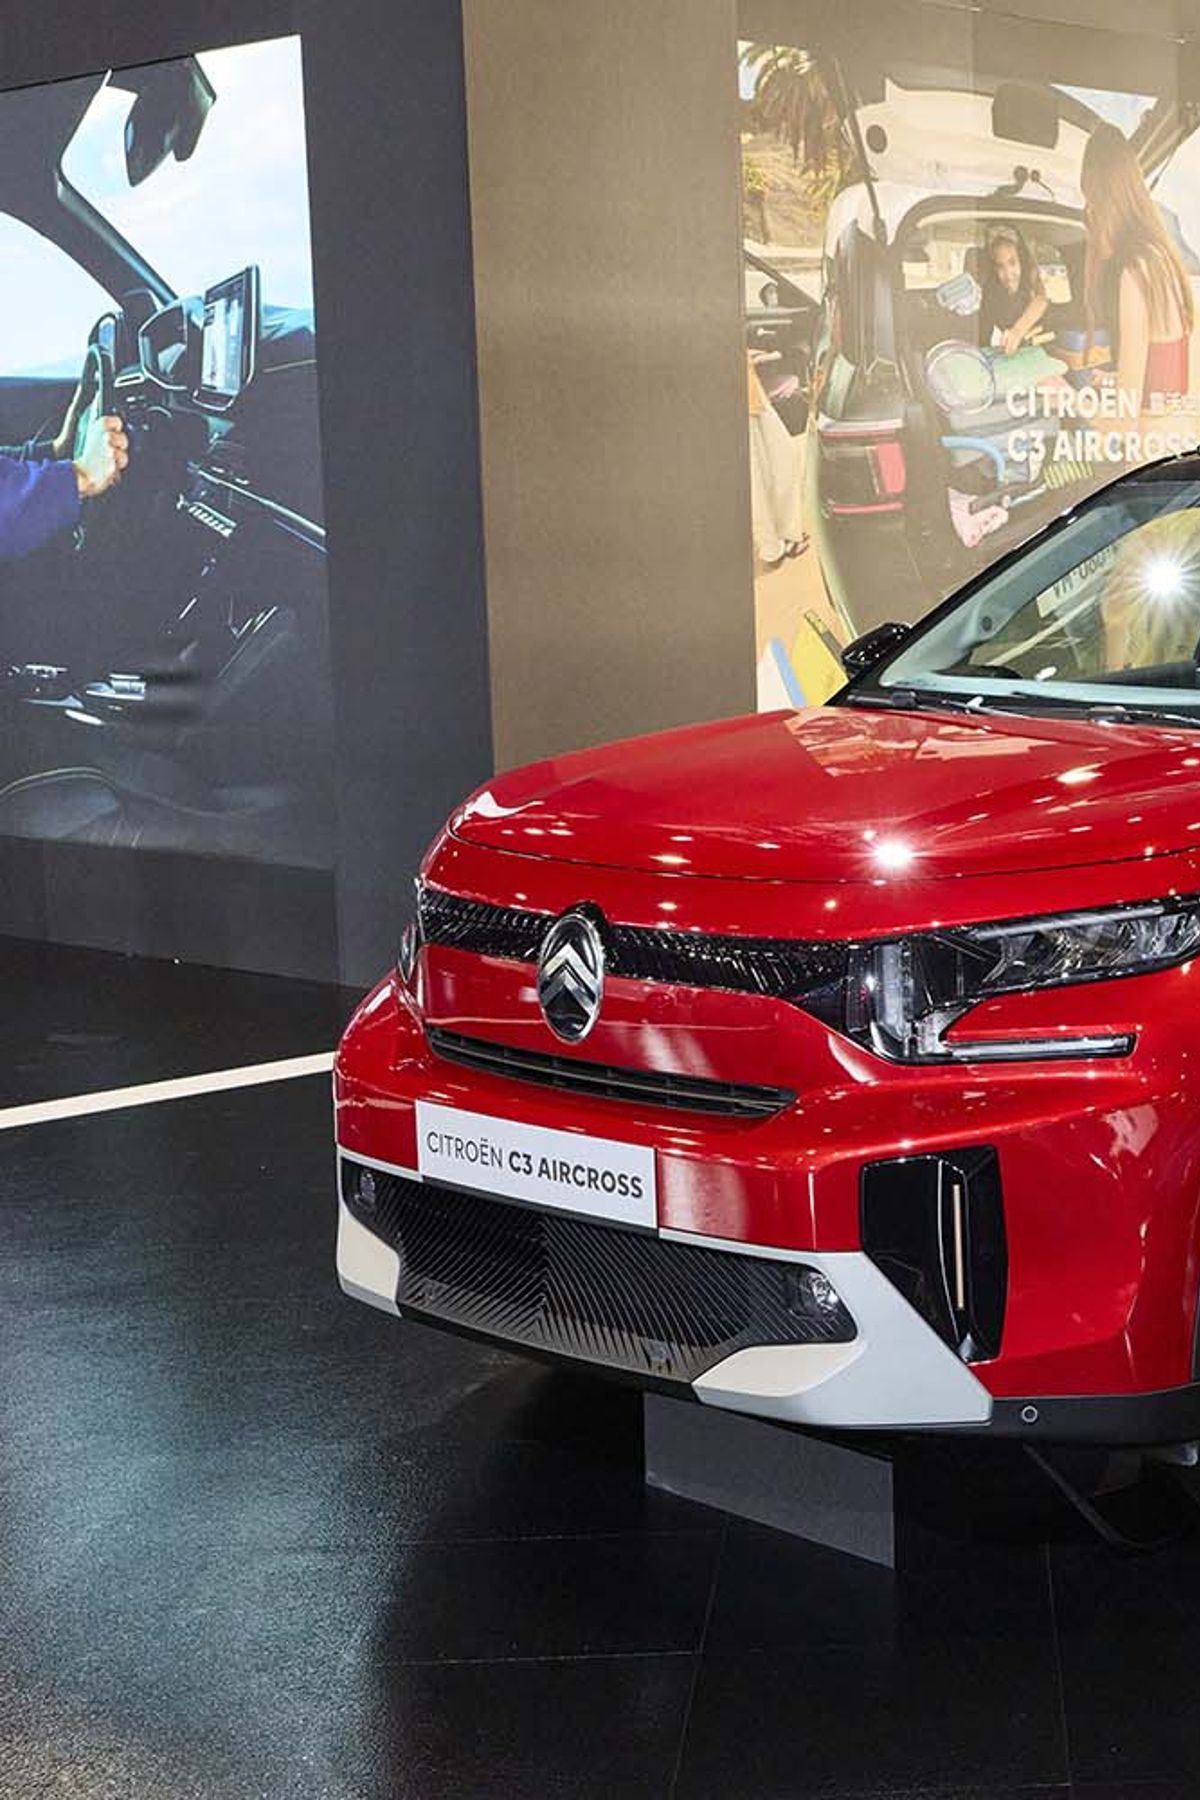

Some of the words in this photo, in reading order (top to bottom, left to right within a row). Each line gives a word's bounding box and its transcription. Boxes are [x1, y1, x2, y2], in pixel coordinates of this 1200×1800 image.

[1006, 378, 1138, 418] CITROËN
[1007, 432, 1045, 461] C3
[426, 1131, 503, 1168] CITROËN
[508, 1150, 533, 1175] C3
[537, 1157, 644, 1200] AIRCROSS
